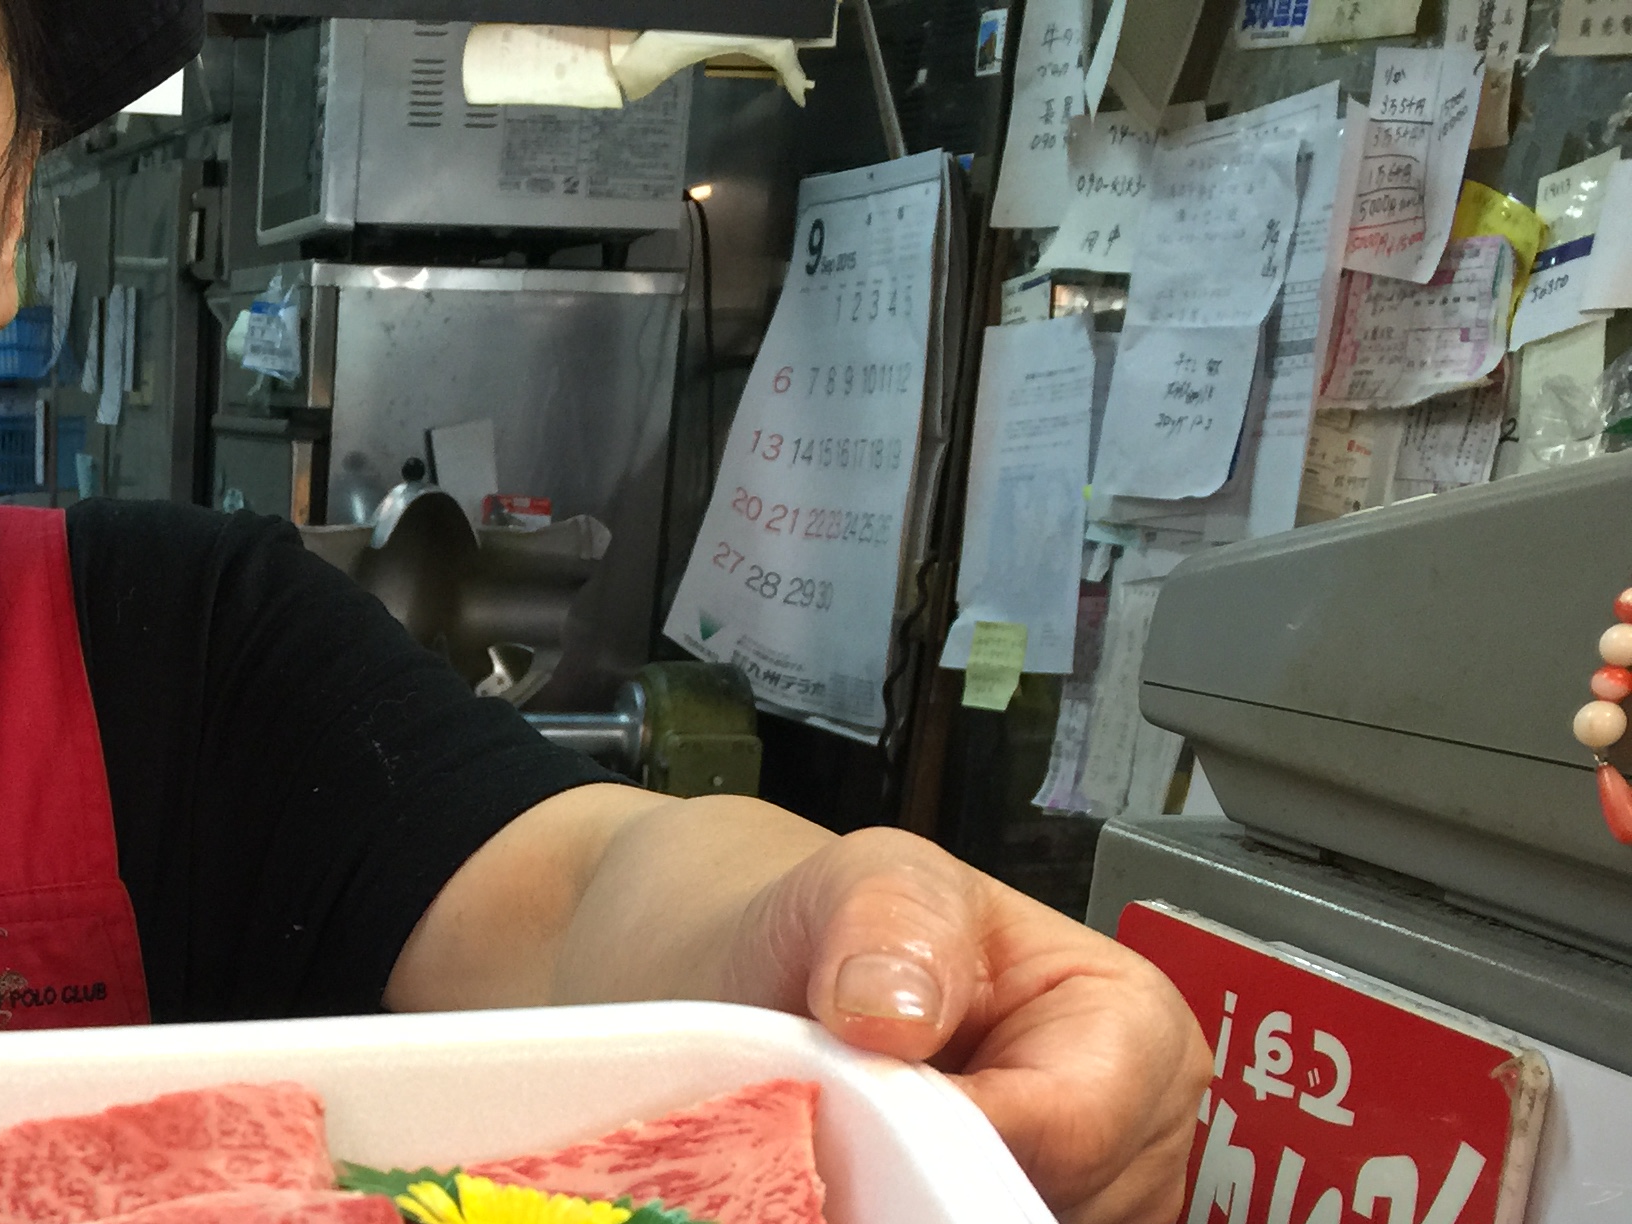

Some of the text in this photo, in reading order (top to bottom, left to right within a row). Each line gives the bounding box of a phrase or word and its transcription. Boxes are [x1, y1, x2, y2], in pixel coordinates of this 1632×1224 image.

[805, 218, 825, 275] 9
[851, 291, 862, 322] 2
[869, 289, 880, 320] 3
[772, 365, 794, 394] 6
[808, 366, 820, 396] 7
[825, 366, 837, 396] 8
[844, 365, 854, 395] 9
[862, 363, 877, 395] 10
[750, 429, 784, 462] 13
[791, 437, 816, 467] 14
[732, 486, 763, 522] 20
[764, 503, 801, 535] 21
[712, 541, 834, 612] 27 28 29 30
[10, 986, 58, 1008] POLO
[61, 982, 107, 1004] CLUB
